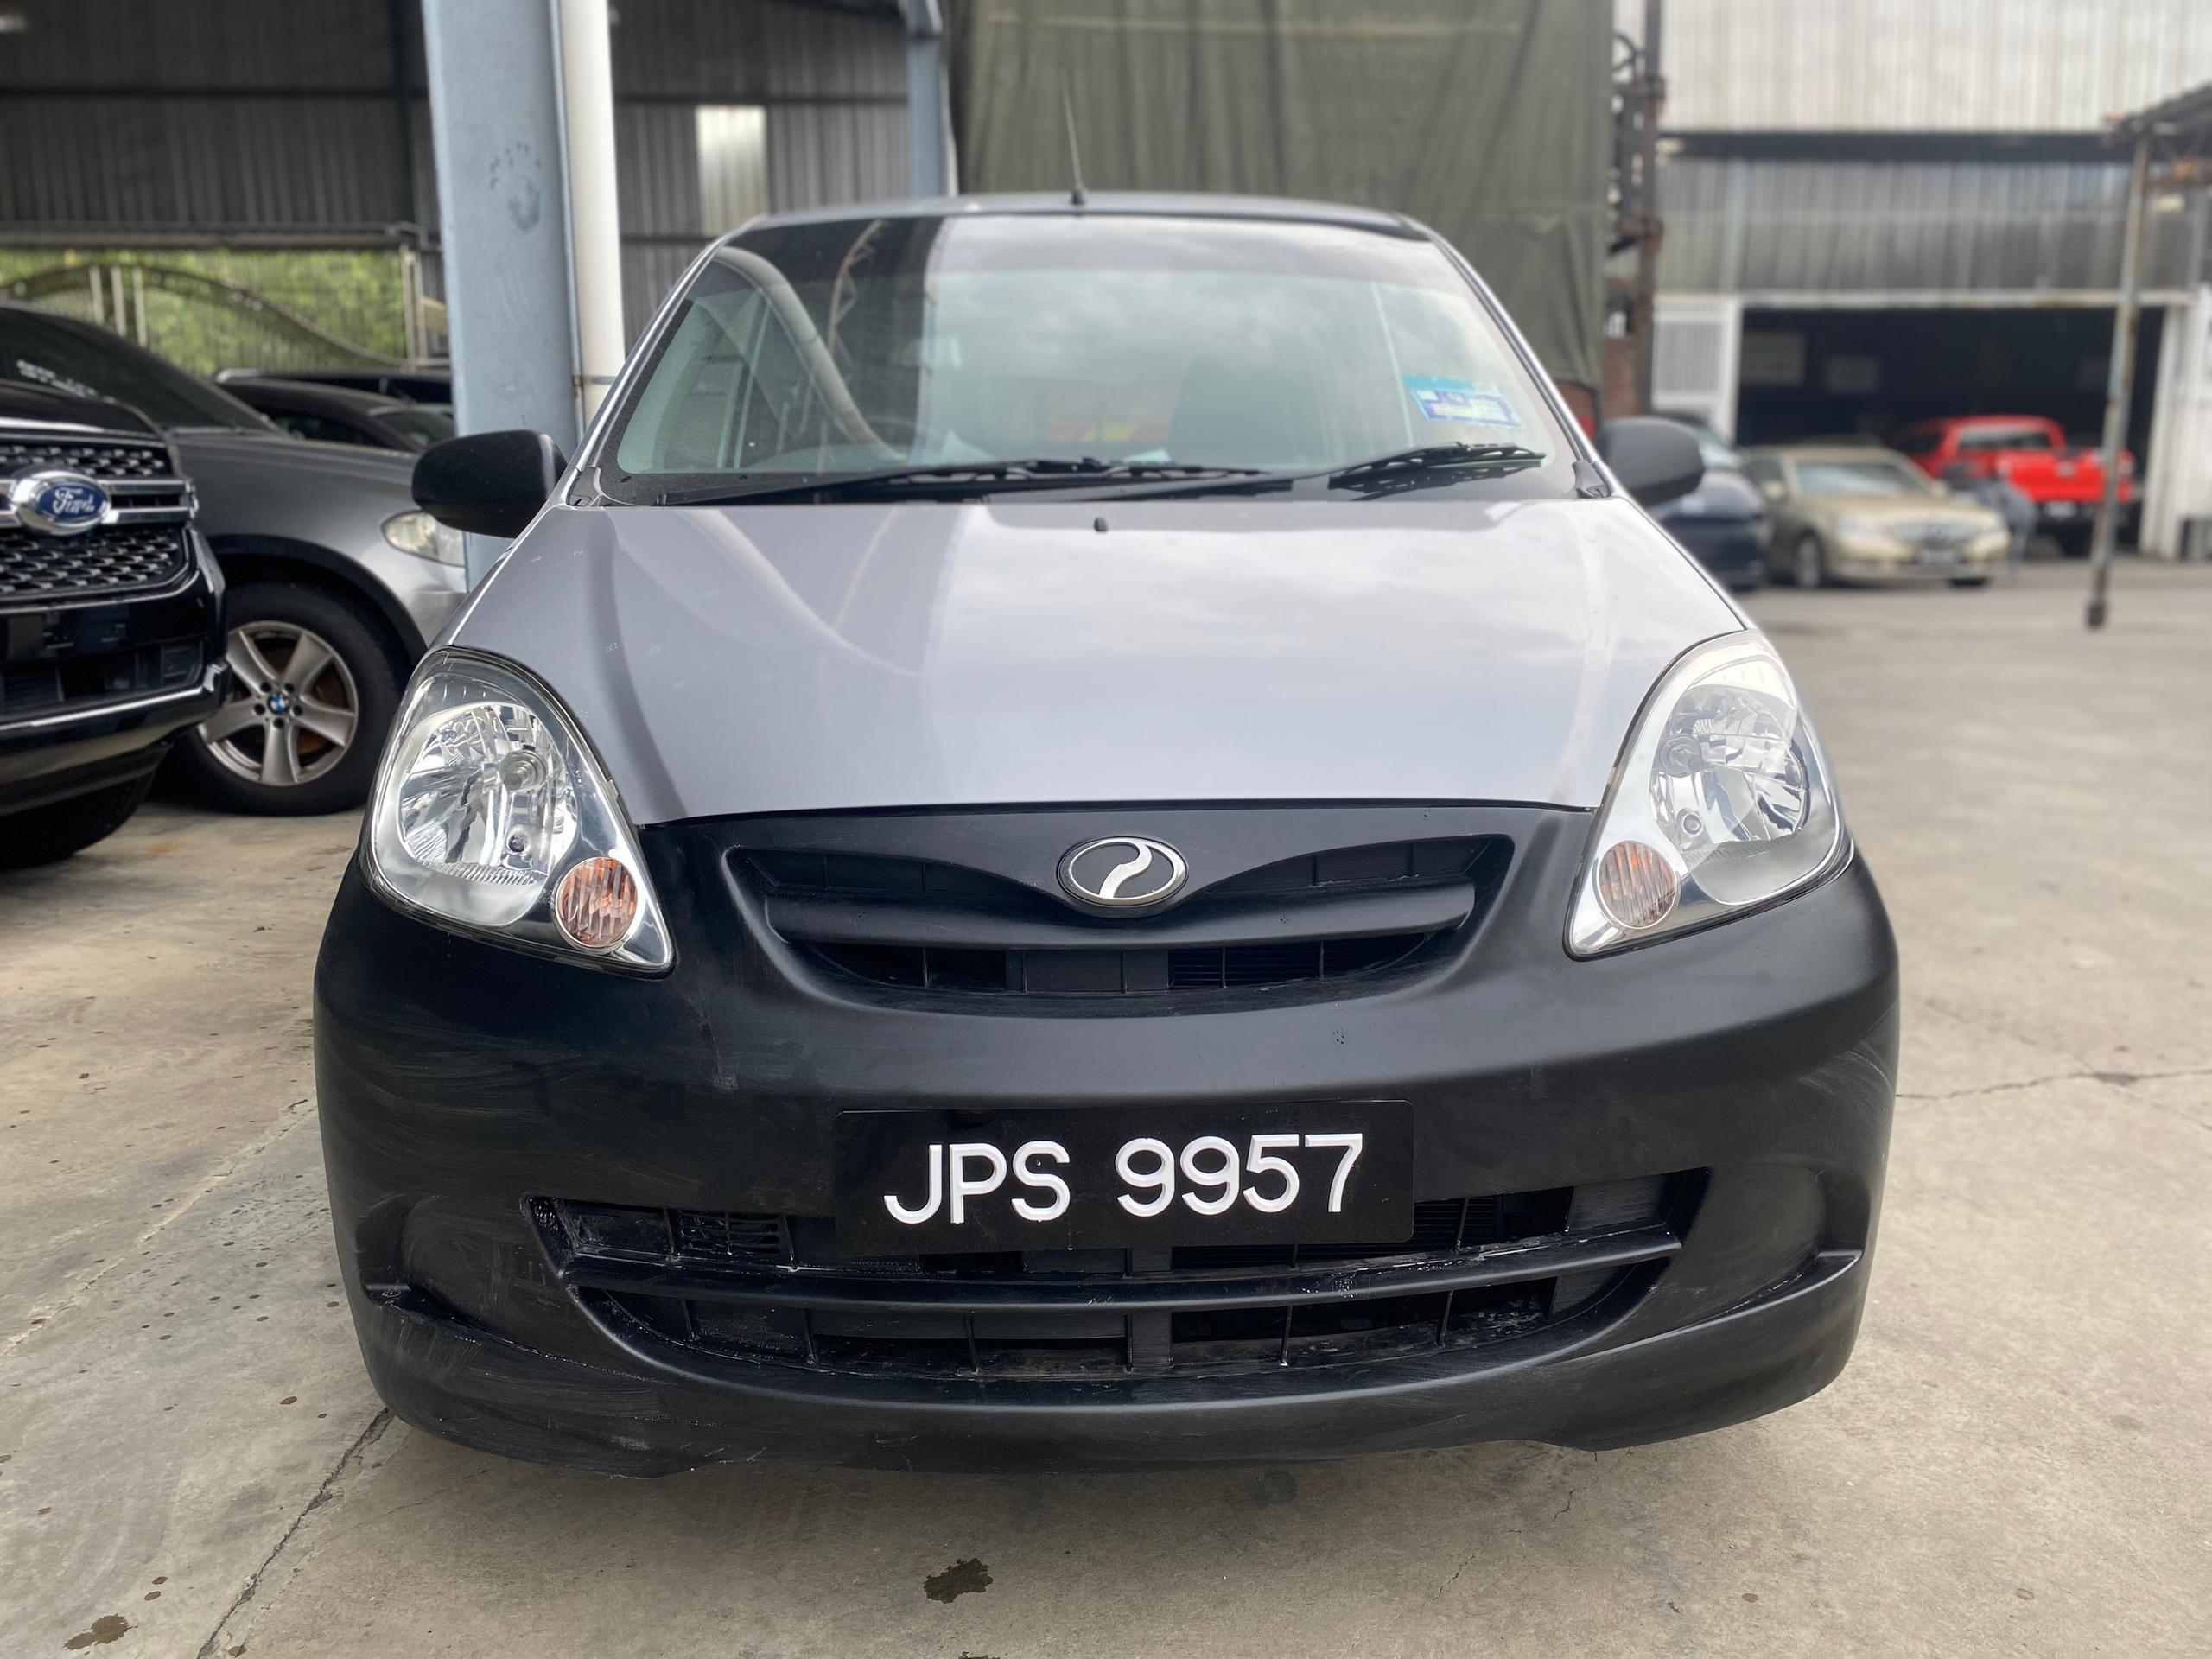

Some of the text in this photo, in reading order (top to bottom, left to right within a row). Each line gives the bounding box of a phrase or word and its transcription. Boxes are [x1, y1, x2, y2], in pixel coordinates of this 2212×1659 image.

[53, 487, 95, 515] Ford
[883, 1133, 1364, 1225] JPS 9957
